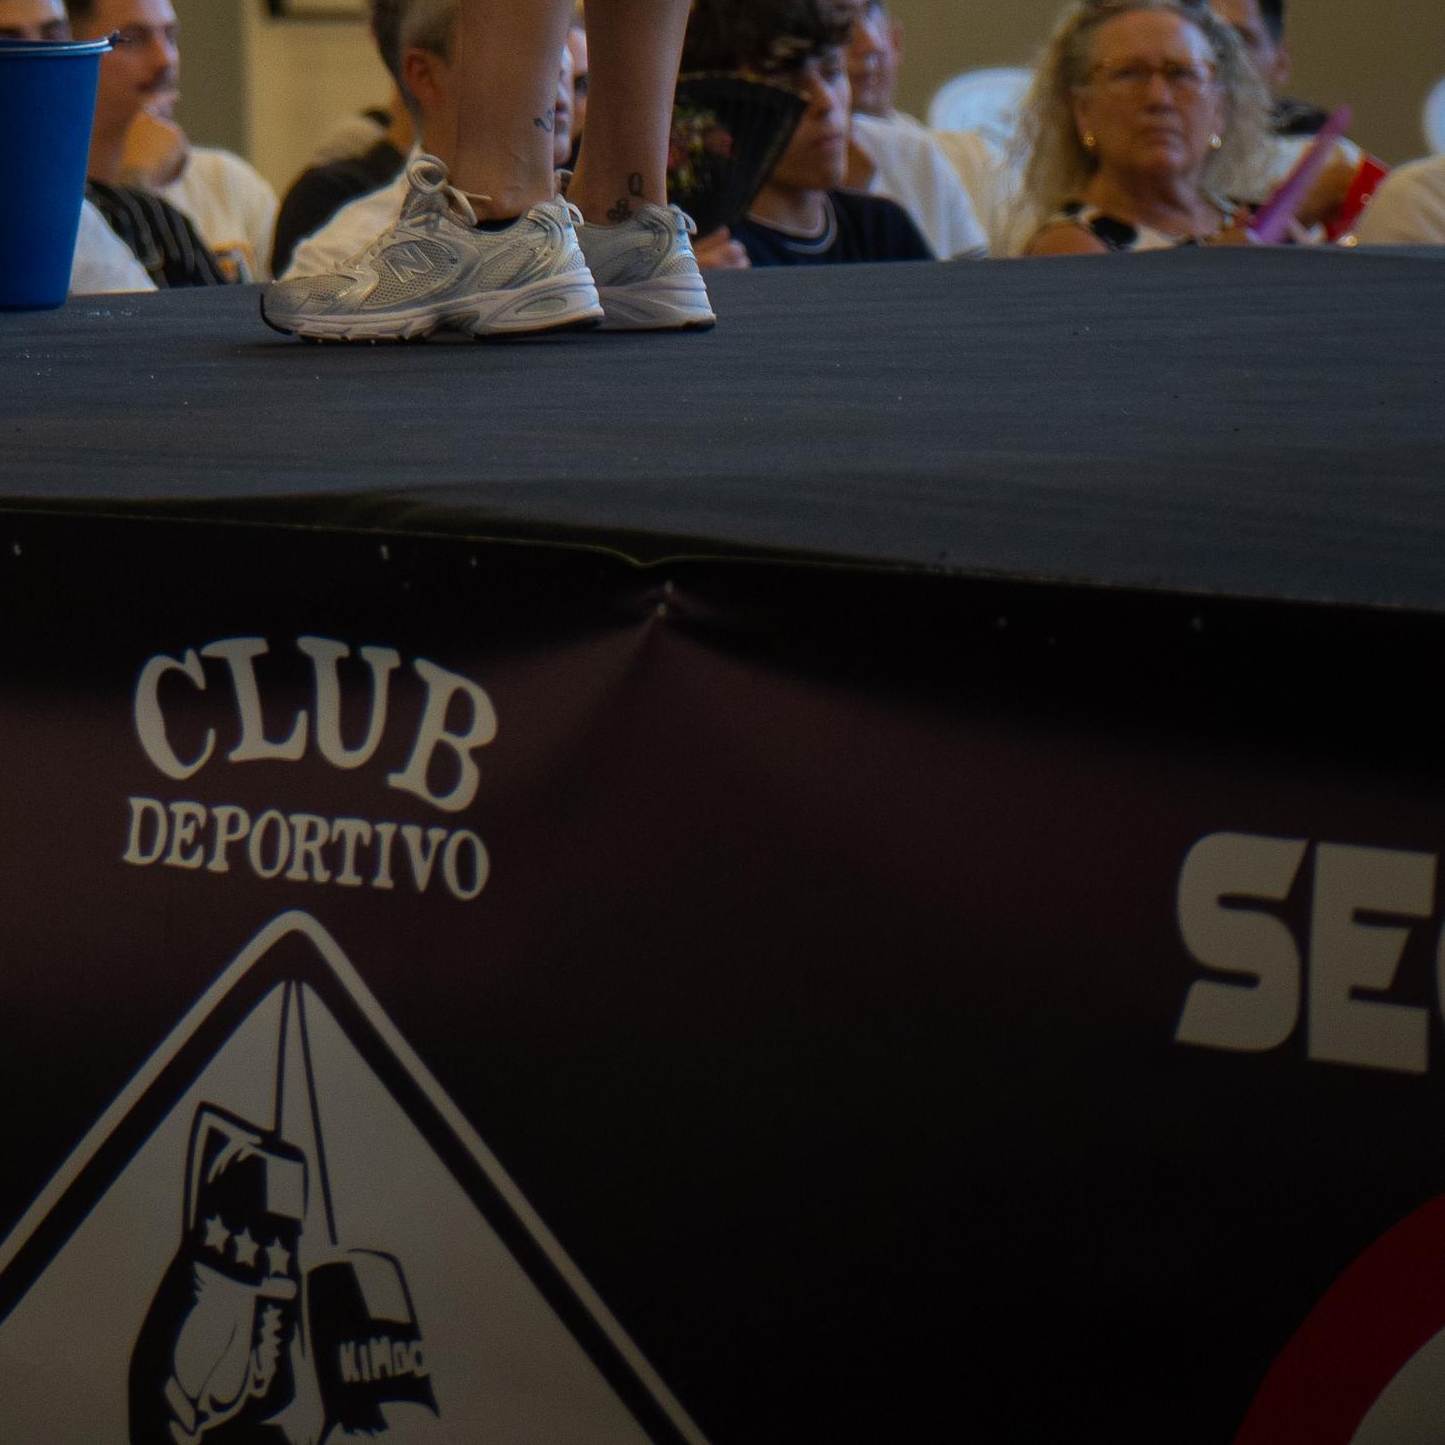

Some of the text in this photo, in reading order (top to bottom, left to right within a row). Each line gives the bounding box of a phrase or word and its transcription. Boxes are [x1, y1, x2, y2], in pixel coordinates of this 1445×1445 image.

[133, 635, 499, 812] CLUB
[121, 795, 491, 901] DEPORTIVO
[1173, 831, 1445, 1077] SE
